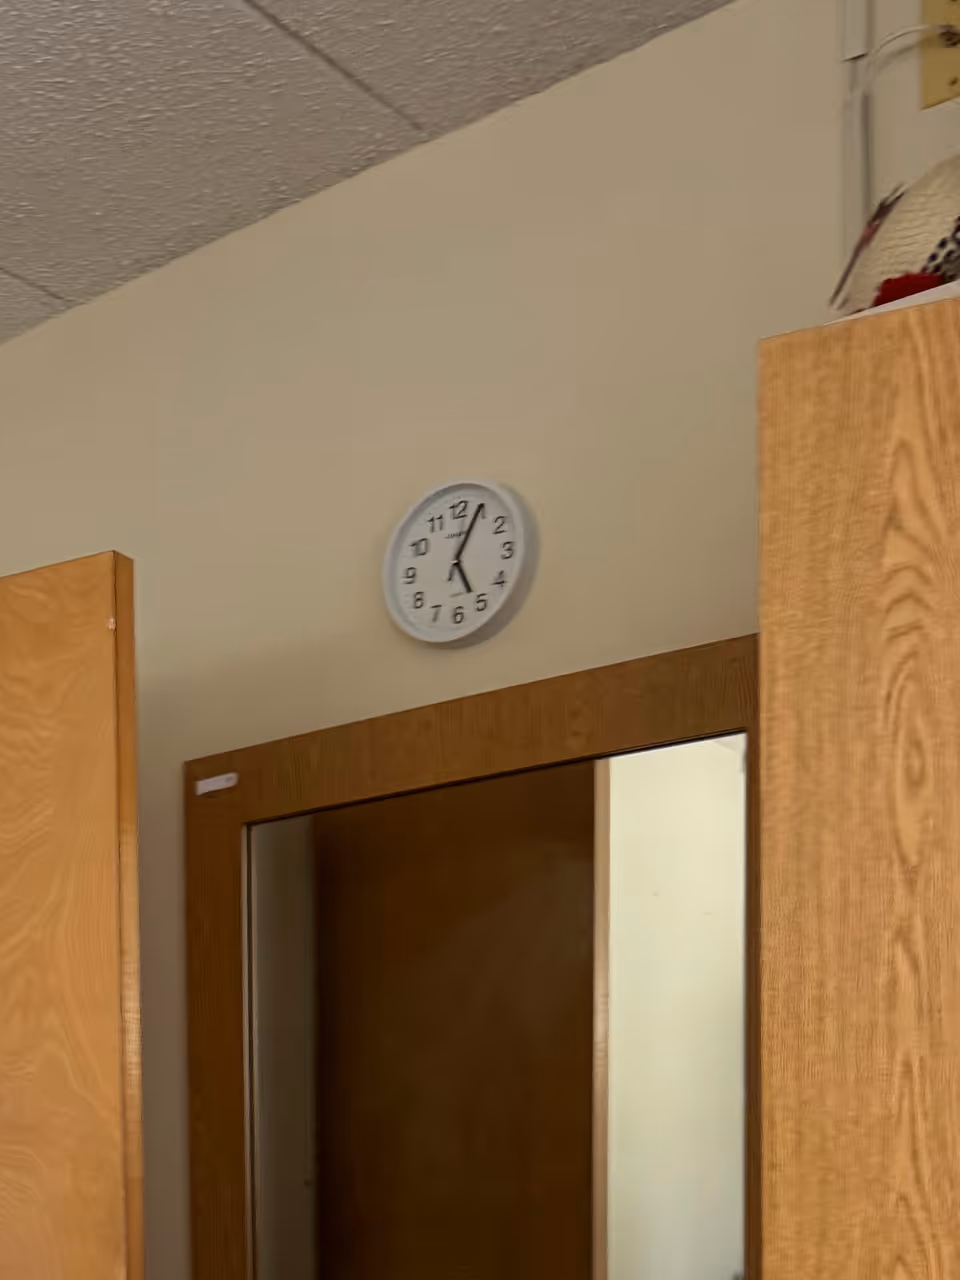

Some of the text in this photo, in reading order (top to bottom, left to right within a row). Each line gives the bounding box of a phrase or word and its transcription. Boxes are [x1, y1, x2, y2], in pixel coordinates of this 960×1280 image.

[449, 500, 469, 520] 12
[427, 514, 444, 533] 11
[492, 515, 507, 534] 2
[409, 538, 428, 556] 10
[501, 541, 514, 560] 3
[403, 567, 416, 585] 9
[491, 570, 506, 587] 4
[413, 591, 424, 609] 8
[476, 593, 487, 611] 5
[431, 604, 442, 622] 7
[452, 606, 464, 624] 6
